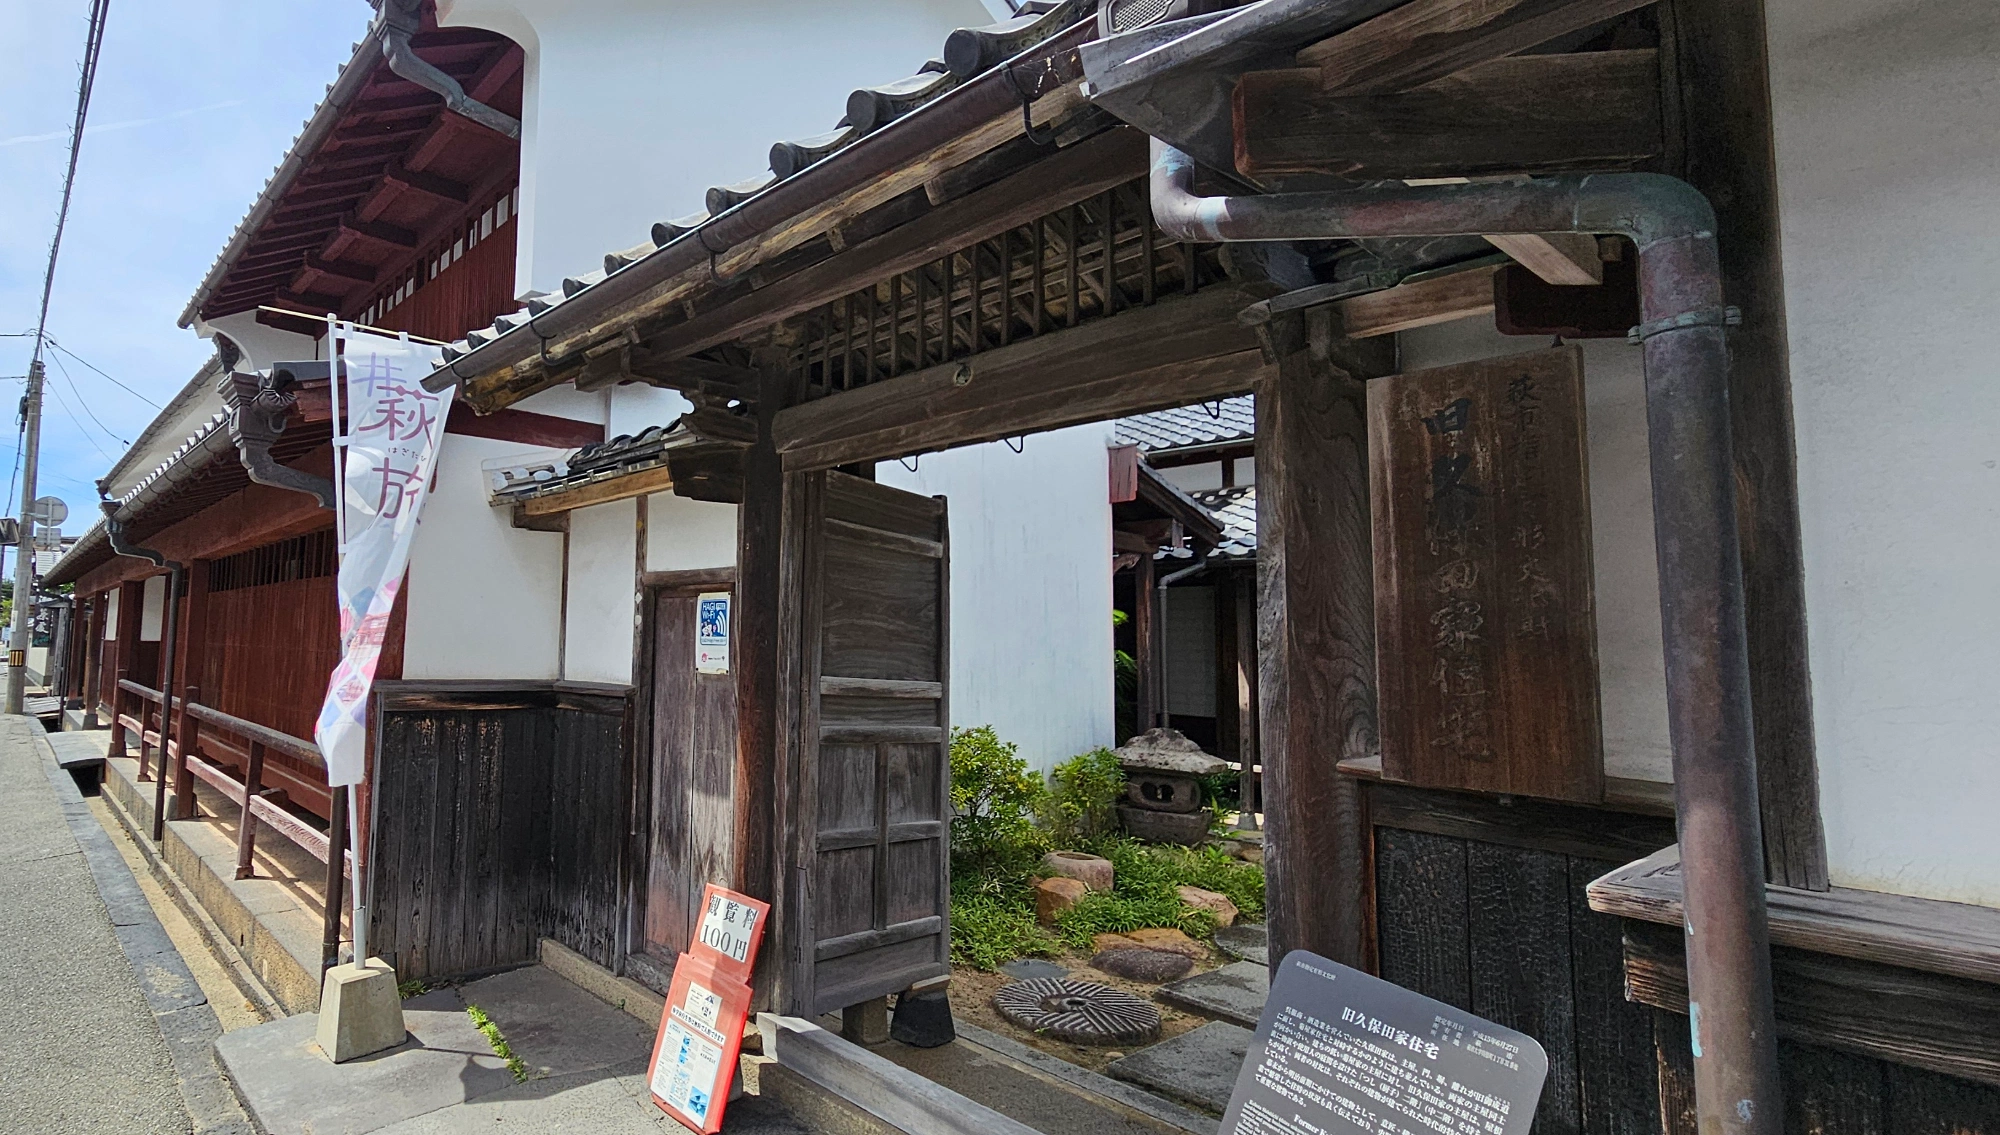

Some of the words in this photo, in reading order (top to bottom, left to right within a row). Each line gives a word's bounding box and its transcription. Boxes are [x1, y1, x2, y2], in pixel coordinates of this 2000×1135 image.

[702, 602, 716, 611] HAGI
[702, 611, 716, 620] Wi-Fi
[708, 893, 759, 931] 観覧料
[702, 924, 747, 961] 100円
[1341, 1006, 1439, 1060] 旧久保田家住宅
[1264, 1047, 1289, 1065] している。
[1293, 1114, 1320, 1134] Former
